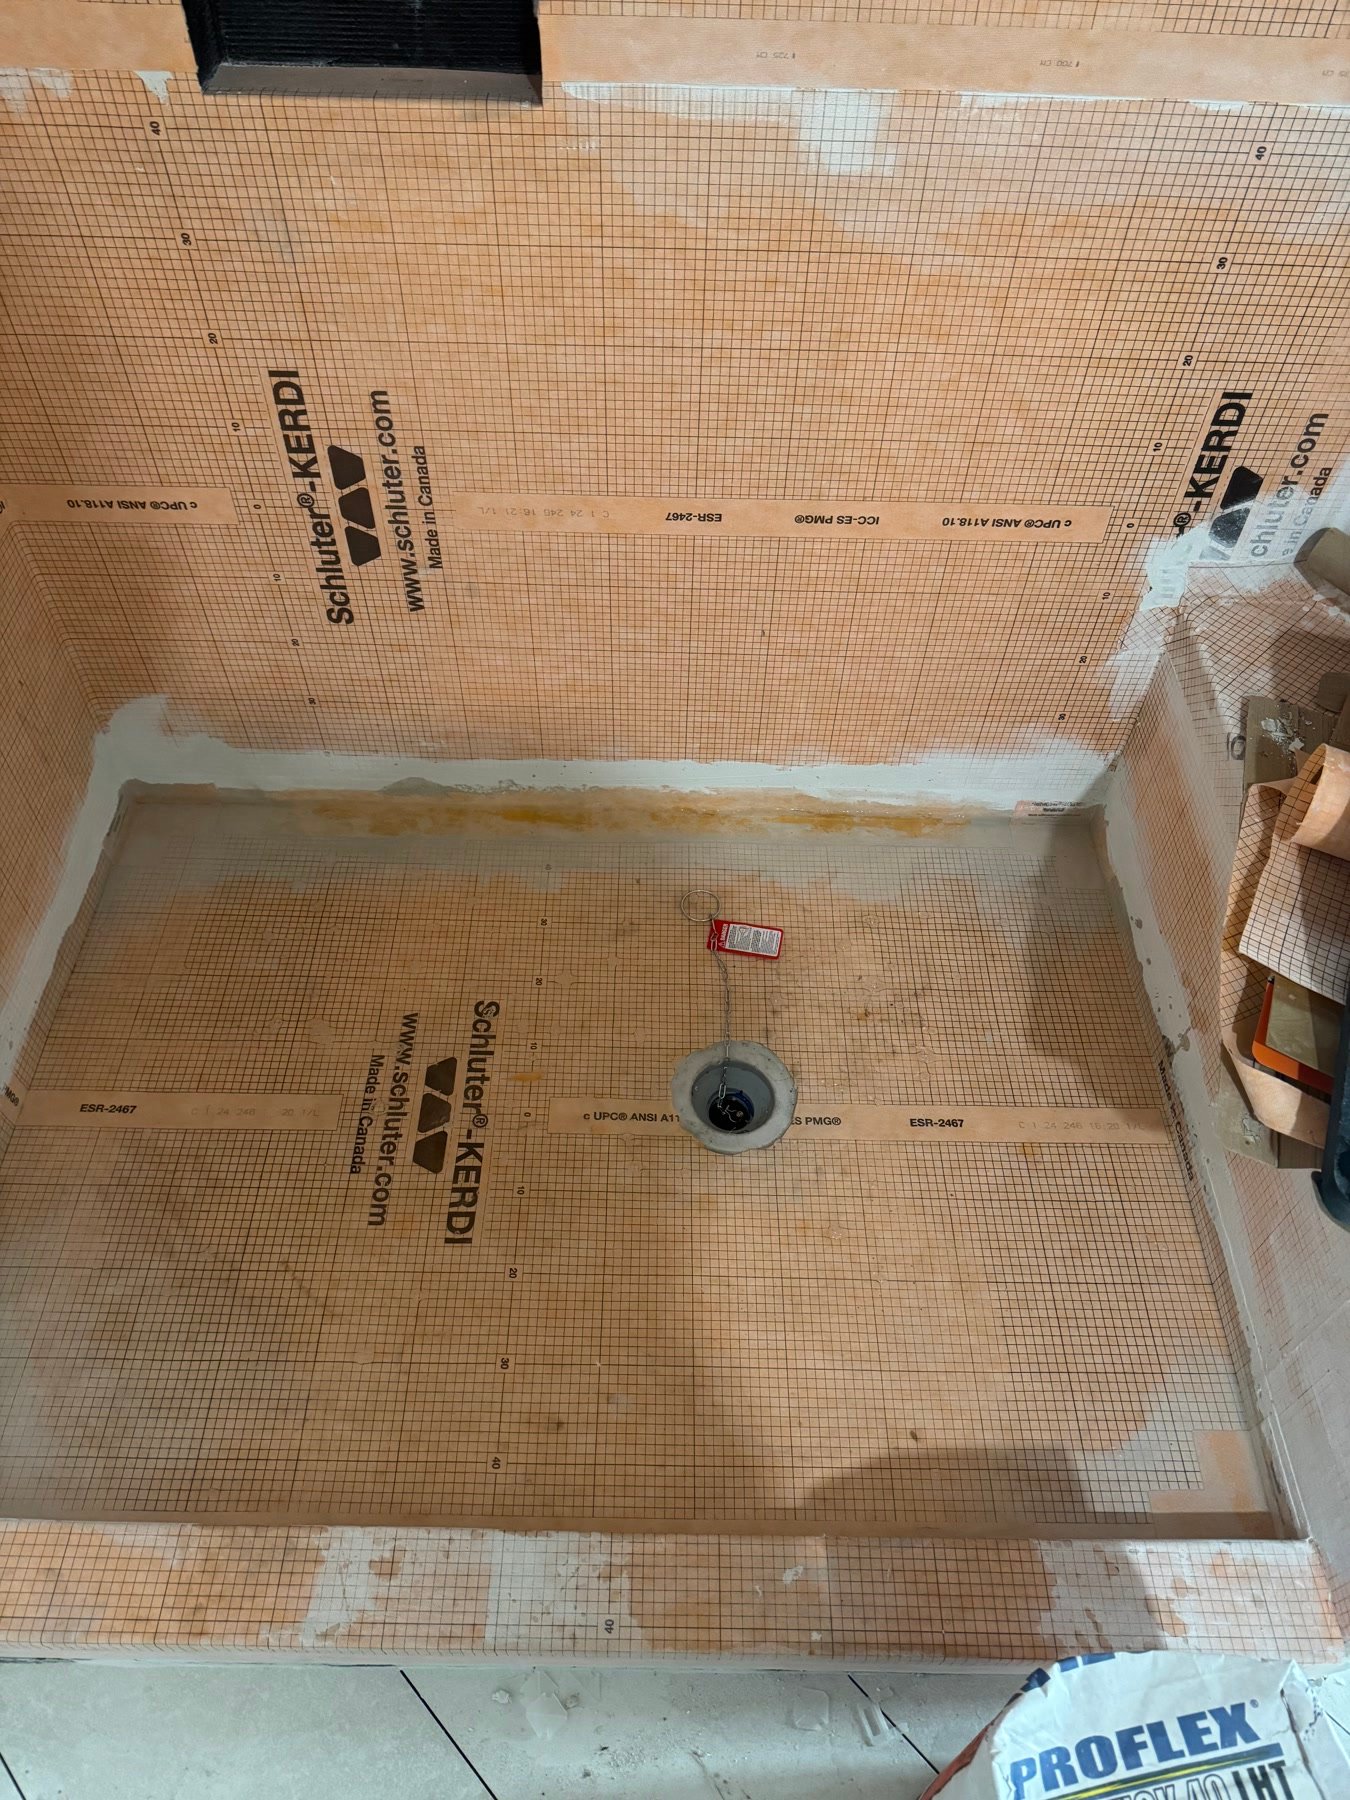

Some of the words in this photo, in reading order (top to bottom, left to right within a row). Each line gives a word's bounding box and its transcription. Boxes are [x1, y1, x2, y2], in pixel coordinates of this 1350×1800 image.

[149, 121, 161, 136] 40
[1255, 146, 1267, 161] 40
[181, 232, 192, 246] 30
[1216, 257, 1228, 270] 30
[208, 332, 219, 345] 20
[1182, 355, 1194, 367] 20
[231, 421, 241, 432] 10
[1153, 442, 1163, 453] 10
[411, 445, 433, 507] Canada
[1250, 412, 1329, 558] chluter.com
[268, 370, 355, 625] Schluter®-KERDI
[370, 389, 425, 613] www.schluter.com
[66, 498, 114, 510] A118.10
[118, 500, 146, 510] ANSI
[150, 500, 188, 511] UPC®
[423, 510, 436, 526] in
[665, 511, 722, 523] ESR-2467
[794, 513, 833, 525] PMG®
[836, 514, 879, 527] ICC-ES
[942, 516, 989, 528] A118.10
[991, 517, 1022, 528] ANSI
[1024, 517, 1061, 529] UPC®
[1064, 519, 1072, 528] c
[426, 528, 444, 569] Made
[272, 573, 281, 582] 10
[1102, 591, 1111, 601] 10
[291, 638, 300, 647] 20
[540, 917, 548, 927] 30
[535, 977, 543, 986] 20
[530, 1042, 538, 1051] 10
[364, 1055, 385, 1094] Made
[79, 1103, 137, 1115] ESR-2467
[362, 1097, 377, 1110] in
[368, 1012, 419, 1226] www.schluter.com
[444, 1000, 500, 1244] Schluter®-KERDI
[583, 1113, 591, 1121] c
[593, 1111, 628, 1122] UPC®
[630, 1112, 658, 1122] ANSI
[804, 1116, 842, 1126] PMG®
[1158, 1059, 1172, 1101] Made
[1175, 1121, 1194, 1182] Canada
[909, 1117, 965, 1129] ESR-2467
[350, 1115, 373, 1175] Canada
[516, 1185, 525, 1195] 10
[508, 1267, 518, 1279] 20
[500, 1357, 510, 1370] 30
[491, 1456, 501, 1470] 40
[604, 1618, 615, 1634] 40
